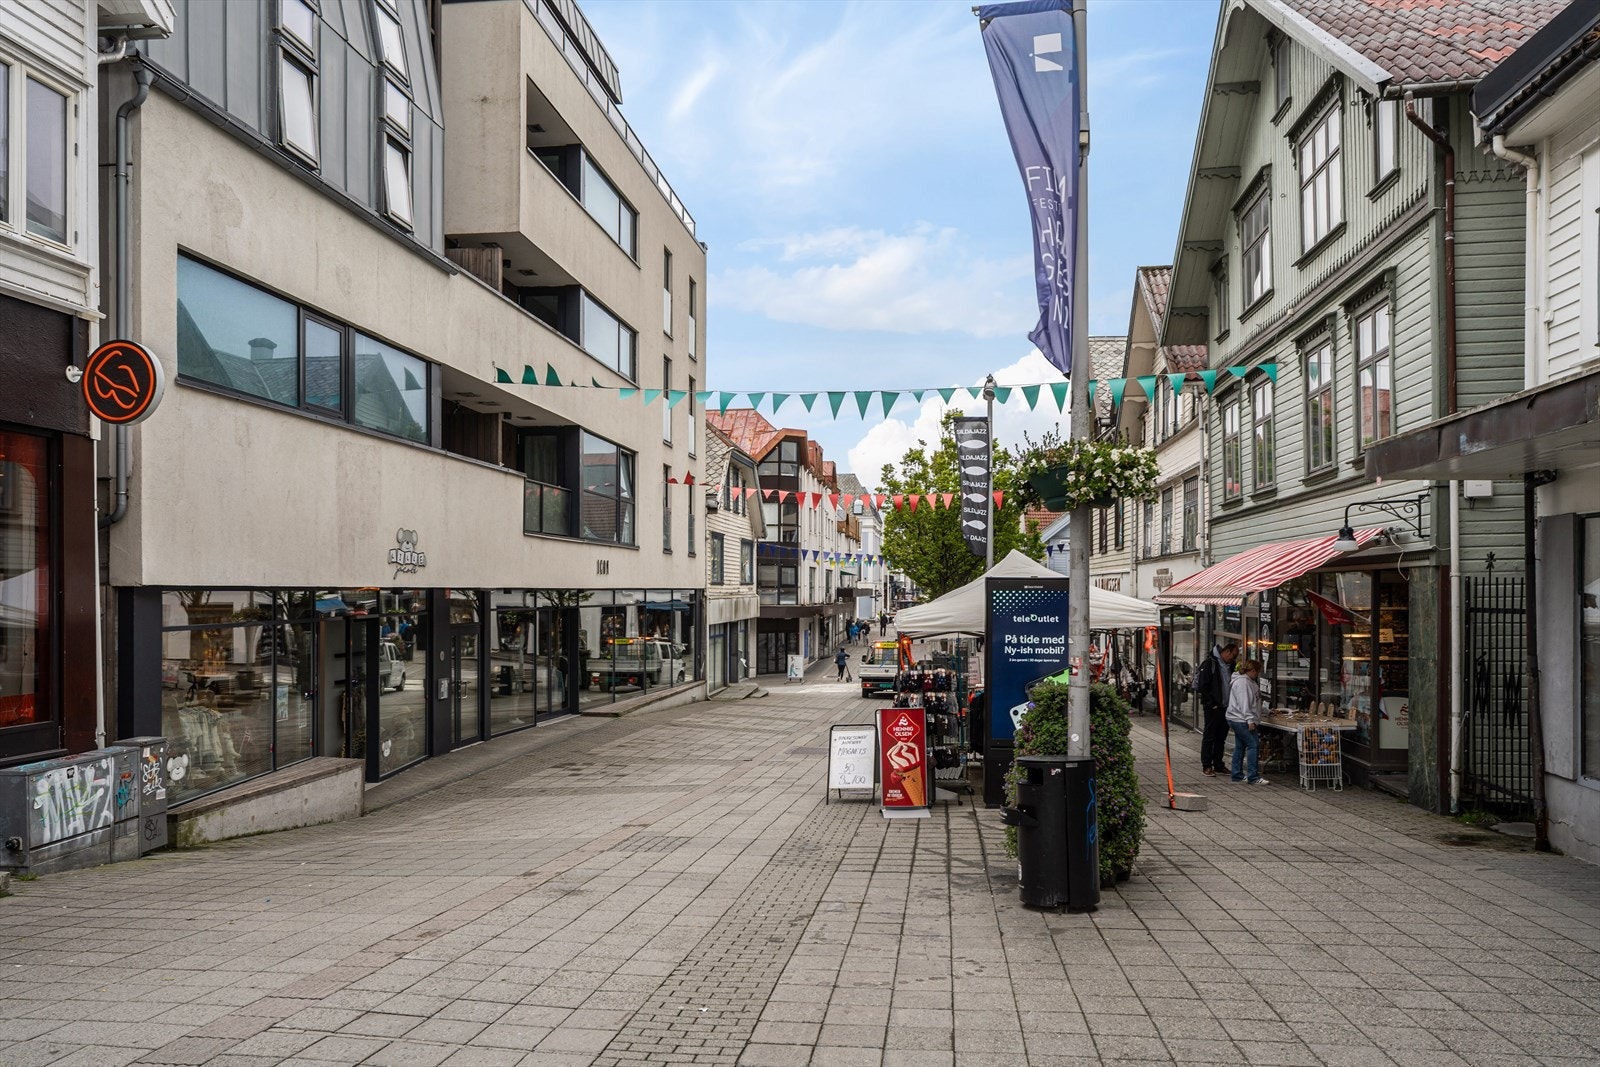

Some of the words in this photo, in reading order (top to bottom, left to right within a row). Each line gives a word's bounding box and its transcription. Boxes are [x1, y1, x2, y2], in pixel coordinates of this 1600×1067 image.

[1005, 634, 1018, 644] På
[1019, 634, 1040, 644] tide
[1041, 635, 1065, 644] med
[1004, 645, 1034, 656] Ny-ish
[1035, 646, 1065, 655] mobil?
